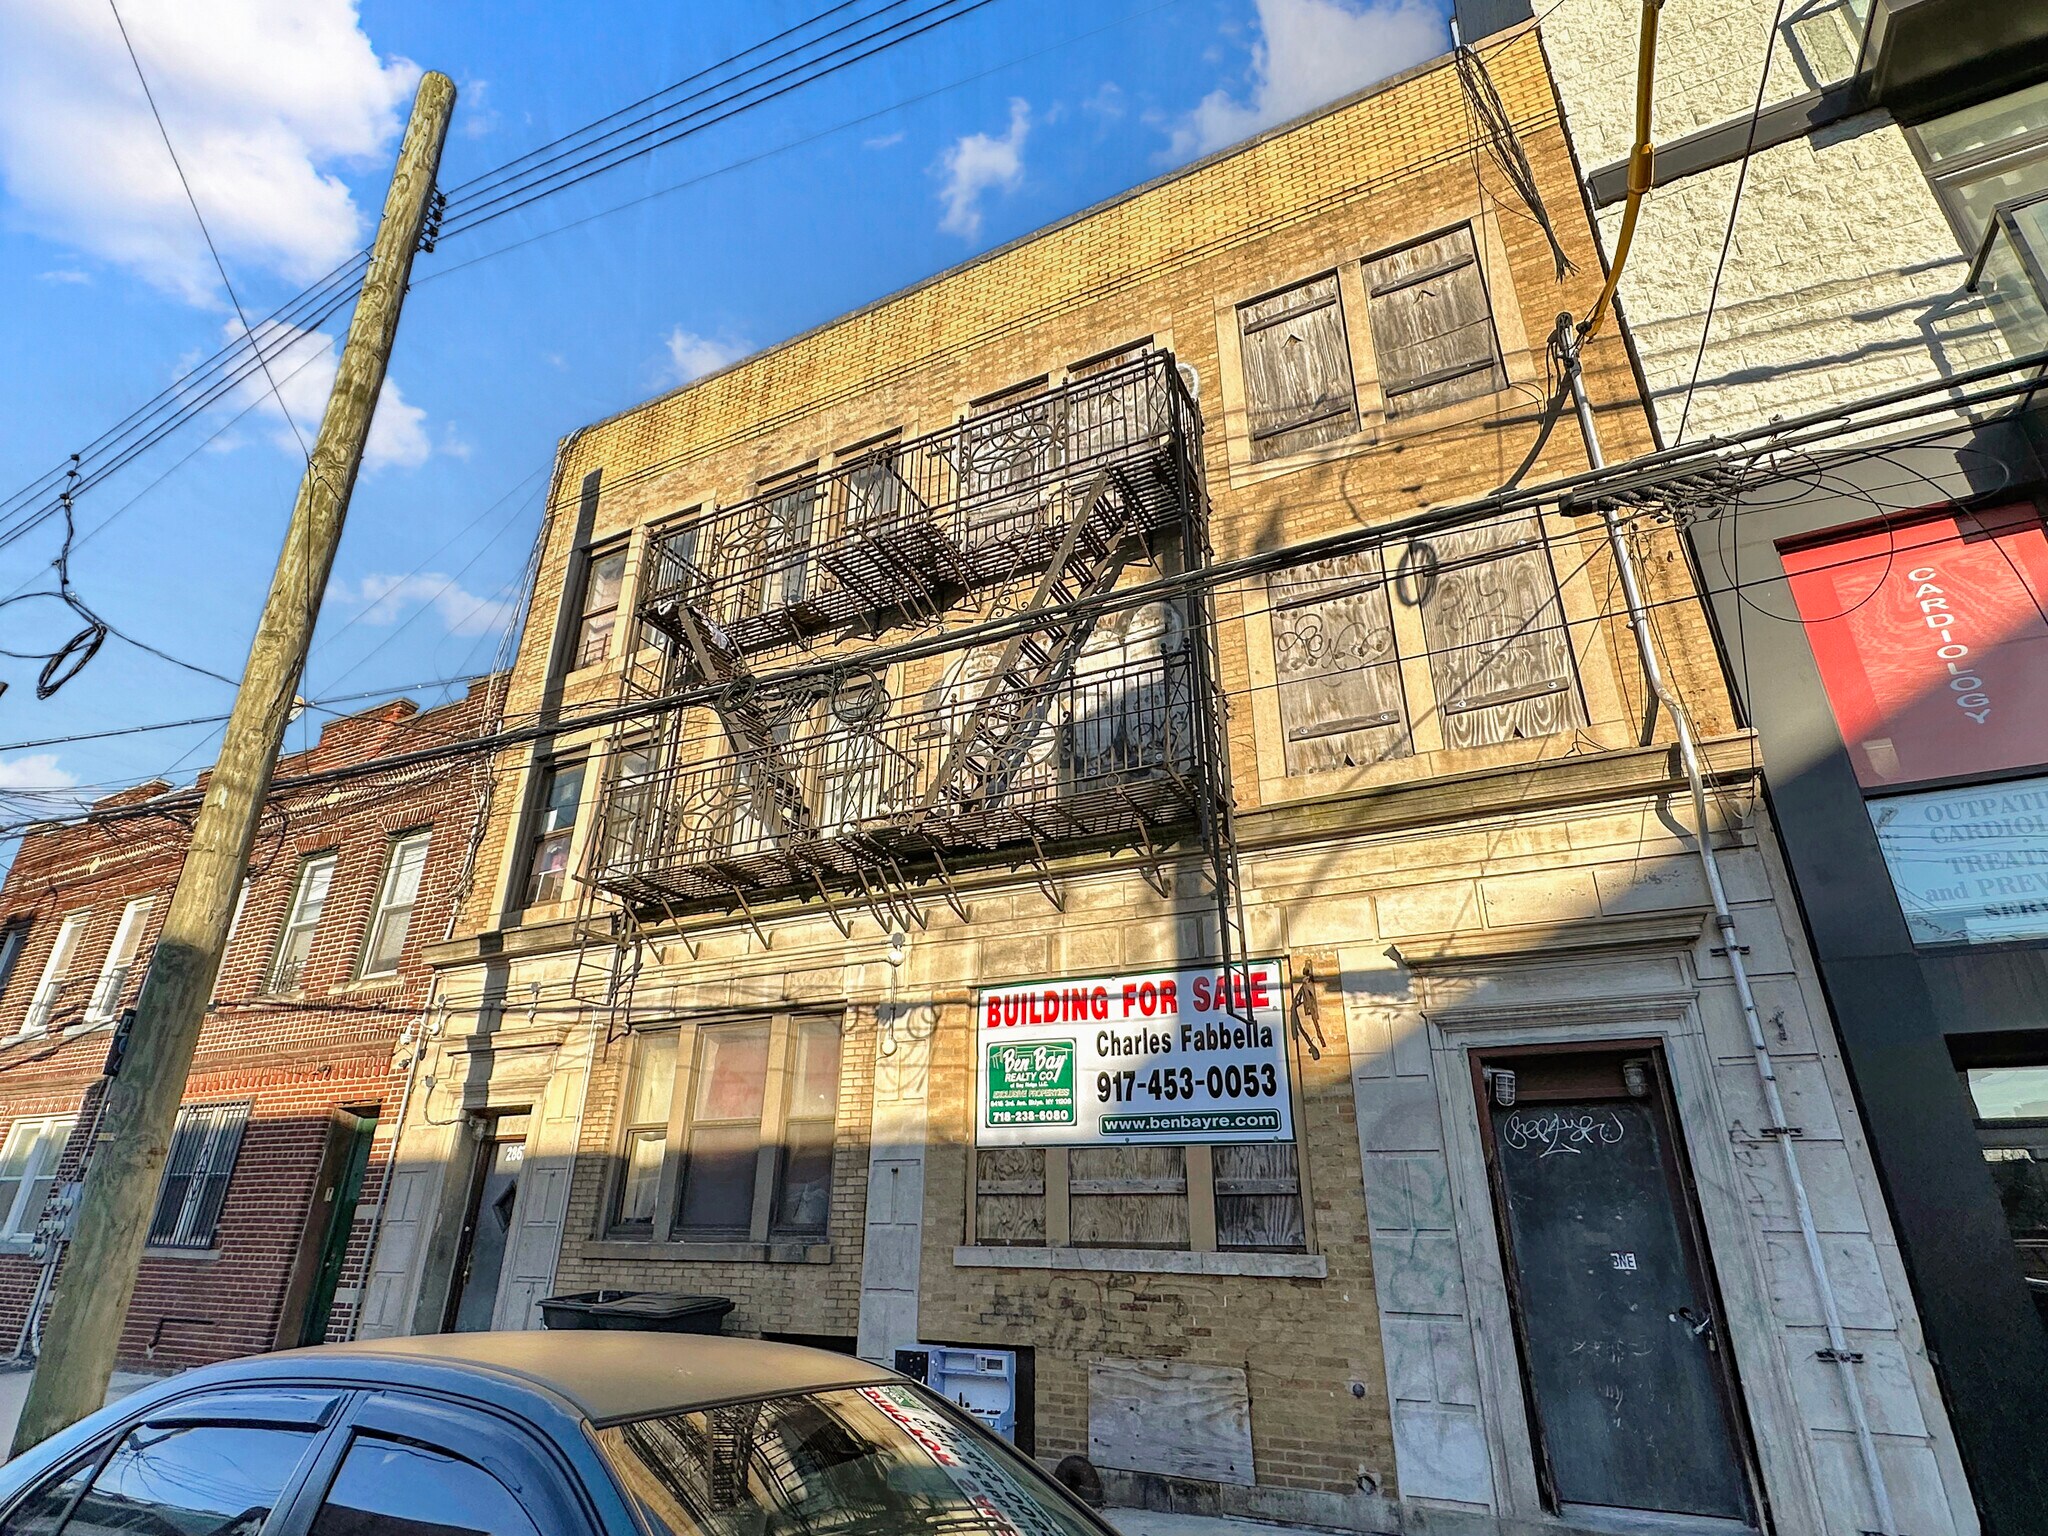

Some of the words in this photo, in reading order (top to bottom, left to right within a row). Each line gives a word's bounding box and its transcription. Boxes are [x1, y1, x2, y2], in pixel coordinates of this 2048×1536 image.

[1908, 567, 1991, 724] CARDIOLOGY
[1924, 791, 2048, 822] OUTPATI
[1925, 881, 1970, 901] and
[987, 985, 1108, 1028] BUILDING
[1123, 979, 1178, 1017] FOR
[1097, 1027, 1171, 1057] Charles
[1181, 1020, 1273, 1051] Fabbella
[1003, 1048, 1030, 1072] Ben
[1033, 1045, 1066, 1083] Bay
[1005, 1072, 1037, 1082] REALTY
[1028, 1089, 1070, 1097] PROPERTIES
[1097, 1063, 1277, 1102] 917-453-0053
[1104, 1113, 1275, 1132] www.benbayre.com
